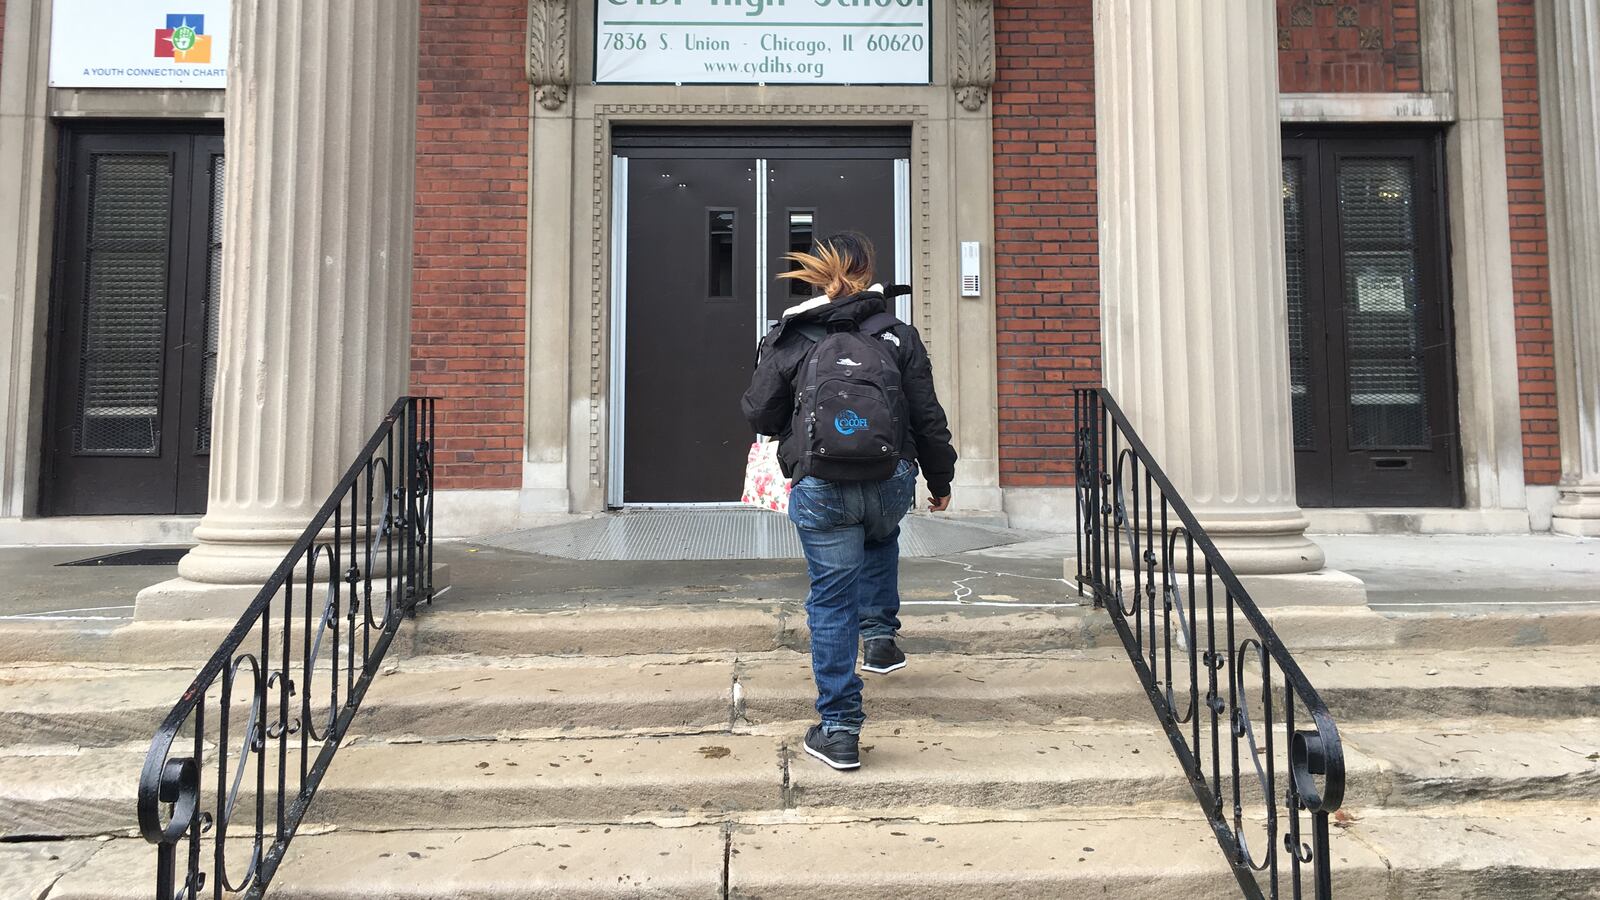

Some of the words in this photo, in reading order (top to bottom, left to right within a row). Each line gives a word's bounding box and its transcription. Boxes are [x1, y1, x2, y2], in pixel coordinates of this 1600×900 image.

[603, 32, 647, 51] 7836
[659, 33, 673, 51] S.
[685, 33, 730, 51] Union
[760, 33, 832, 56] Chicago,
[842, 34, 854, 51] IL
[867, 34, 924, 52] 60620
[83, 68, 90, 76] A
[92, 68, 124, 76] YOUTH
[126, 68, 190, 77] CONNECTION
[192, 68, 227, 77] CHART
[703, 56, 824, 78] www.cydihs.org
